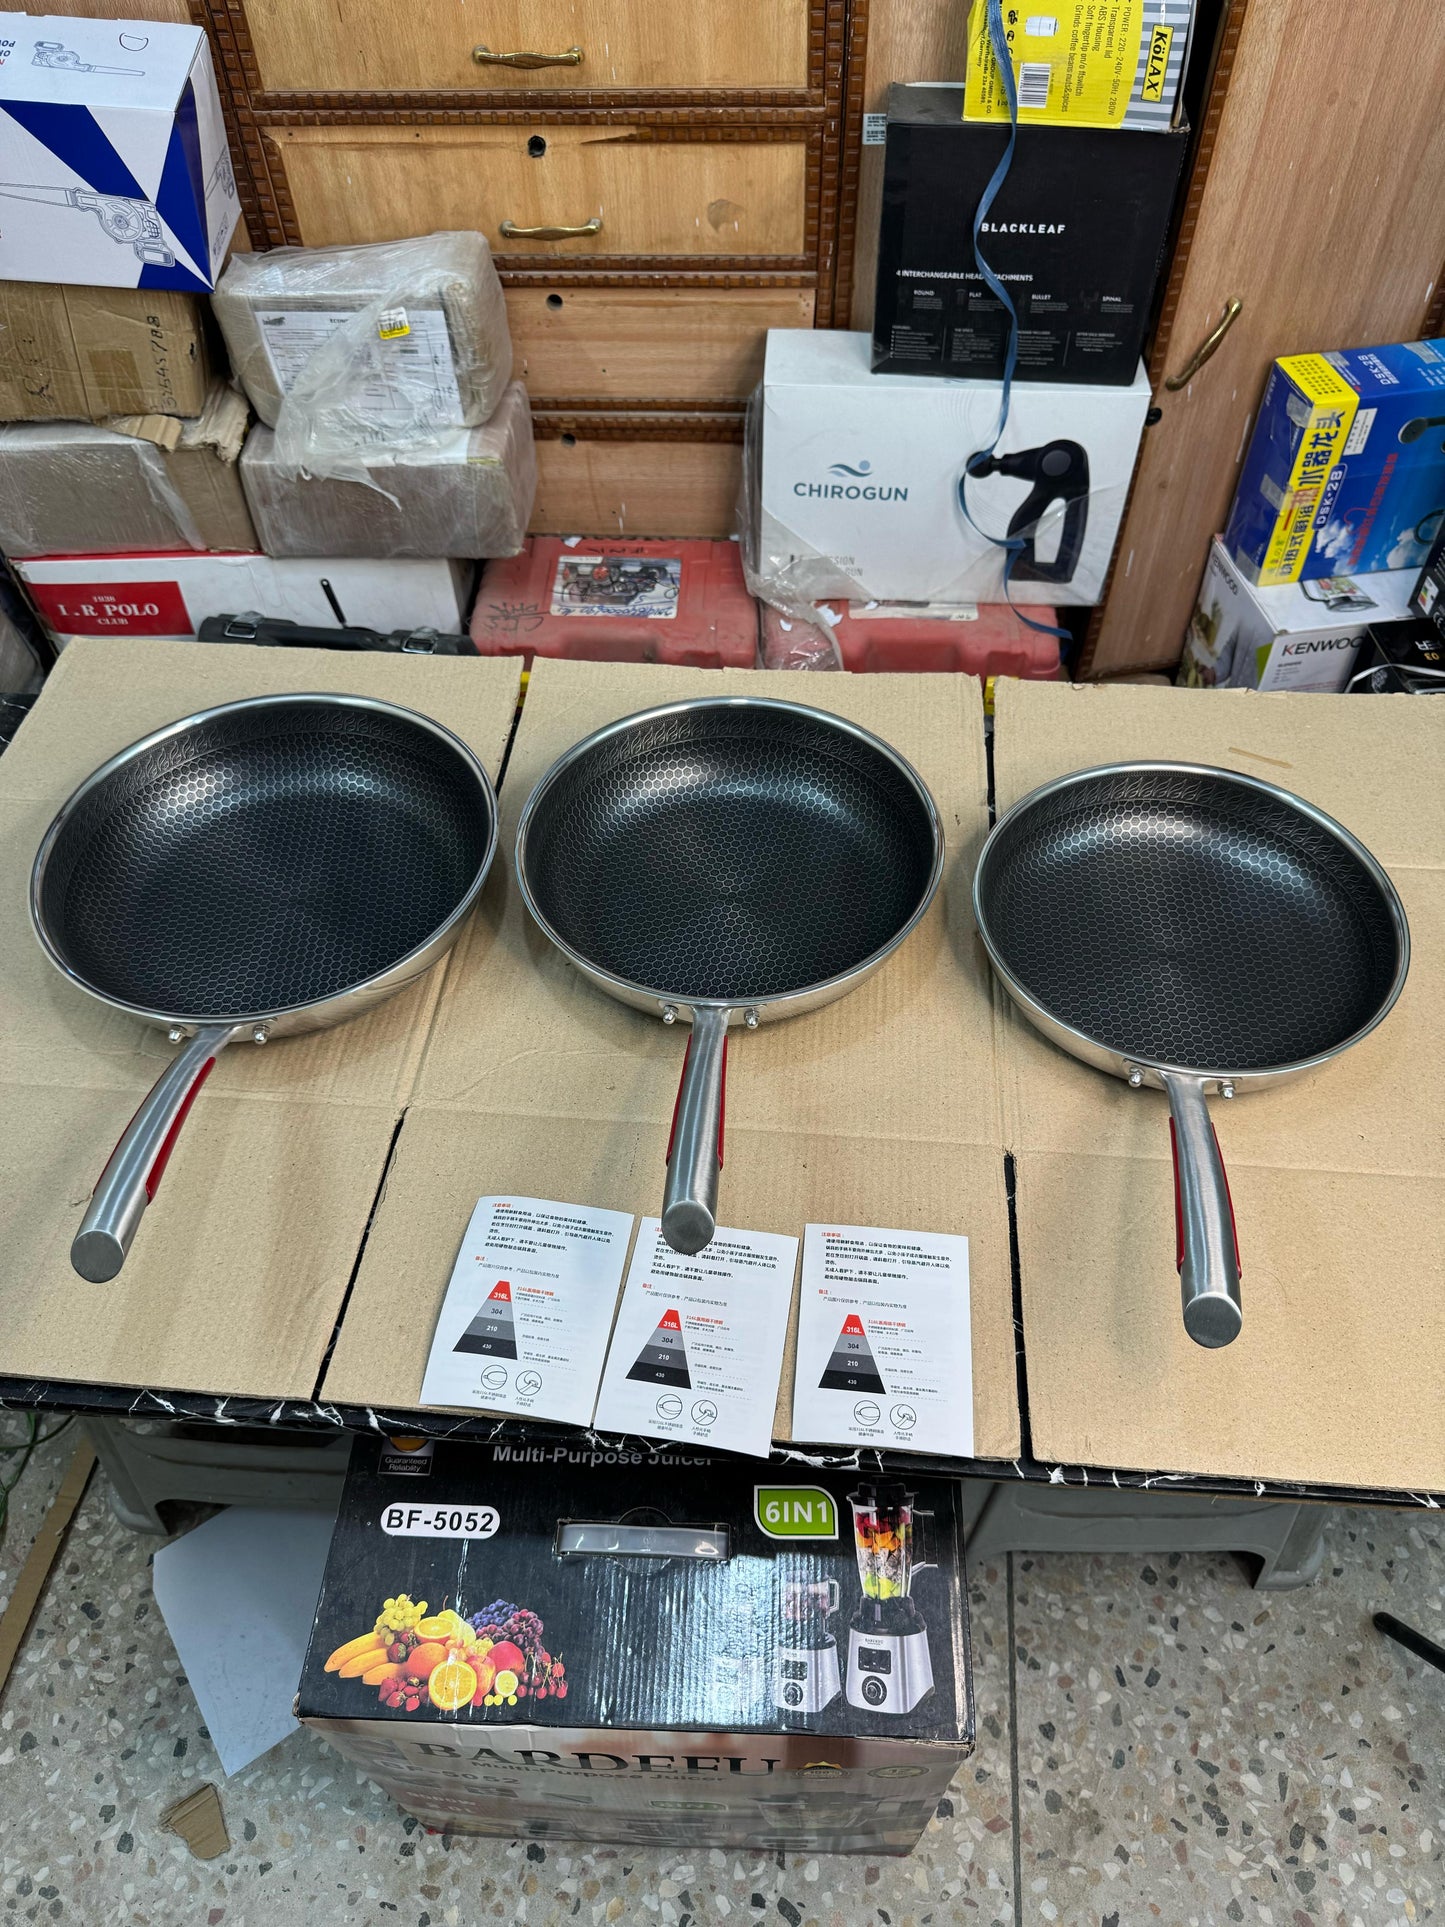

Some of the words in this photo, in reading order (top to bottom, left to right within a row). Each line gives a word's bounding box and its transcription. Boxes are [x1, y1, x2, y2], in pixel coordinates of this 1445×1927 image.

[1074, 4, 1084, 28] Grinds
[1086, 5, 1096, 21] Soft
[1098, 6, 1108, 22] ABS
[1108, 6, 1120, 48] Transparent
[1070, 30, 1079, 52] coffee
[1080, 22, 1092, 52] fingertip
[1092, 23, 1104, 52] Housing
[1104, 50, 1112, 59] lid
[1068, 53, 1078, 74] beans
[1108, 98, 1117, 116] 280W
[981, 222, 1066, 234] BLACKLEAF
[902, 270, 964, 280] INTERCHANGEABLE
[793, 482, 908, 502] CHIROGUN
[1212, 554, 1238, 596] KENWOOD
[104, 604, 160, 616] POLO
[1282, 636, 1364, 657] KENWOO
[493, 1292, 508, 1300] 316L
[490, 1308, 503, 1316] 304
[486, 1324, 498, 1332] 210
[663, 1320, 678, 1328] 316L
[846, 1326, 862, 1334] 316L
[848, 1342, 860, 1350] 304
[385, 1456, 428, 1465] Guaranteed
[492, 1446, 642, 1467] Multi-Purpose
[389, 1464, 420, 1472] Reliability
[386, 1508, 494, 1532] BF-5052
[765, 1501, 828, 1524] 6IN1
